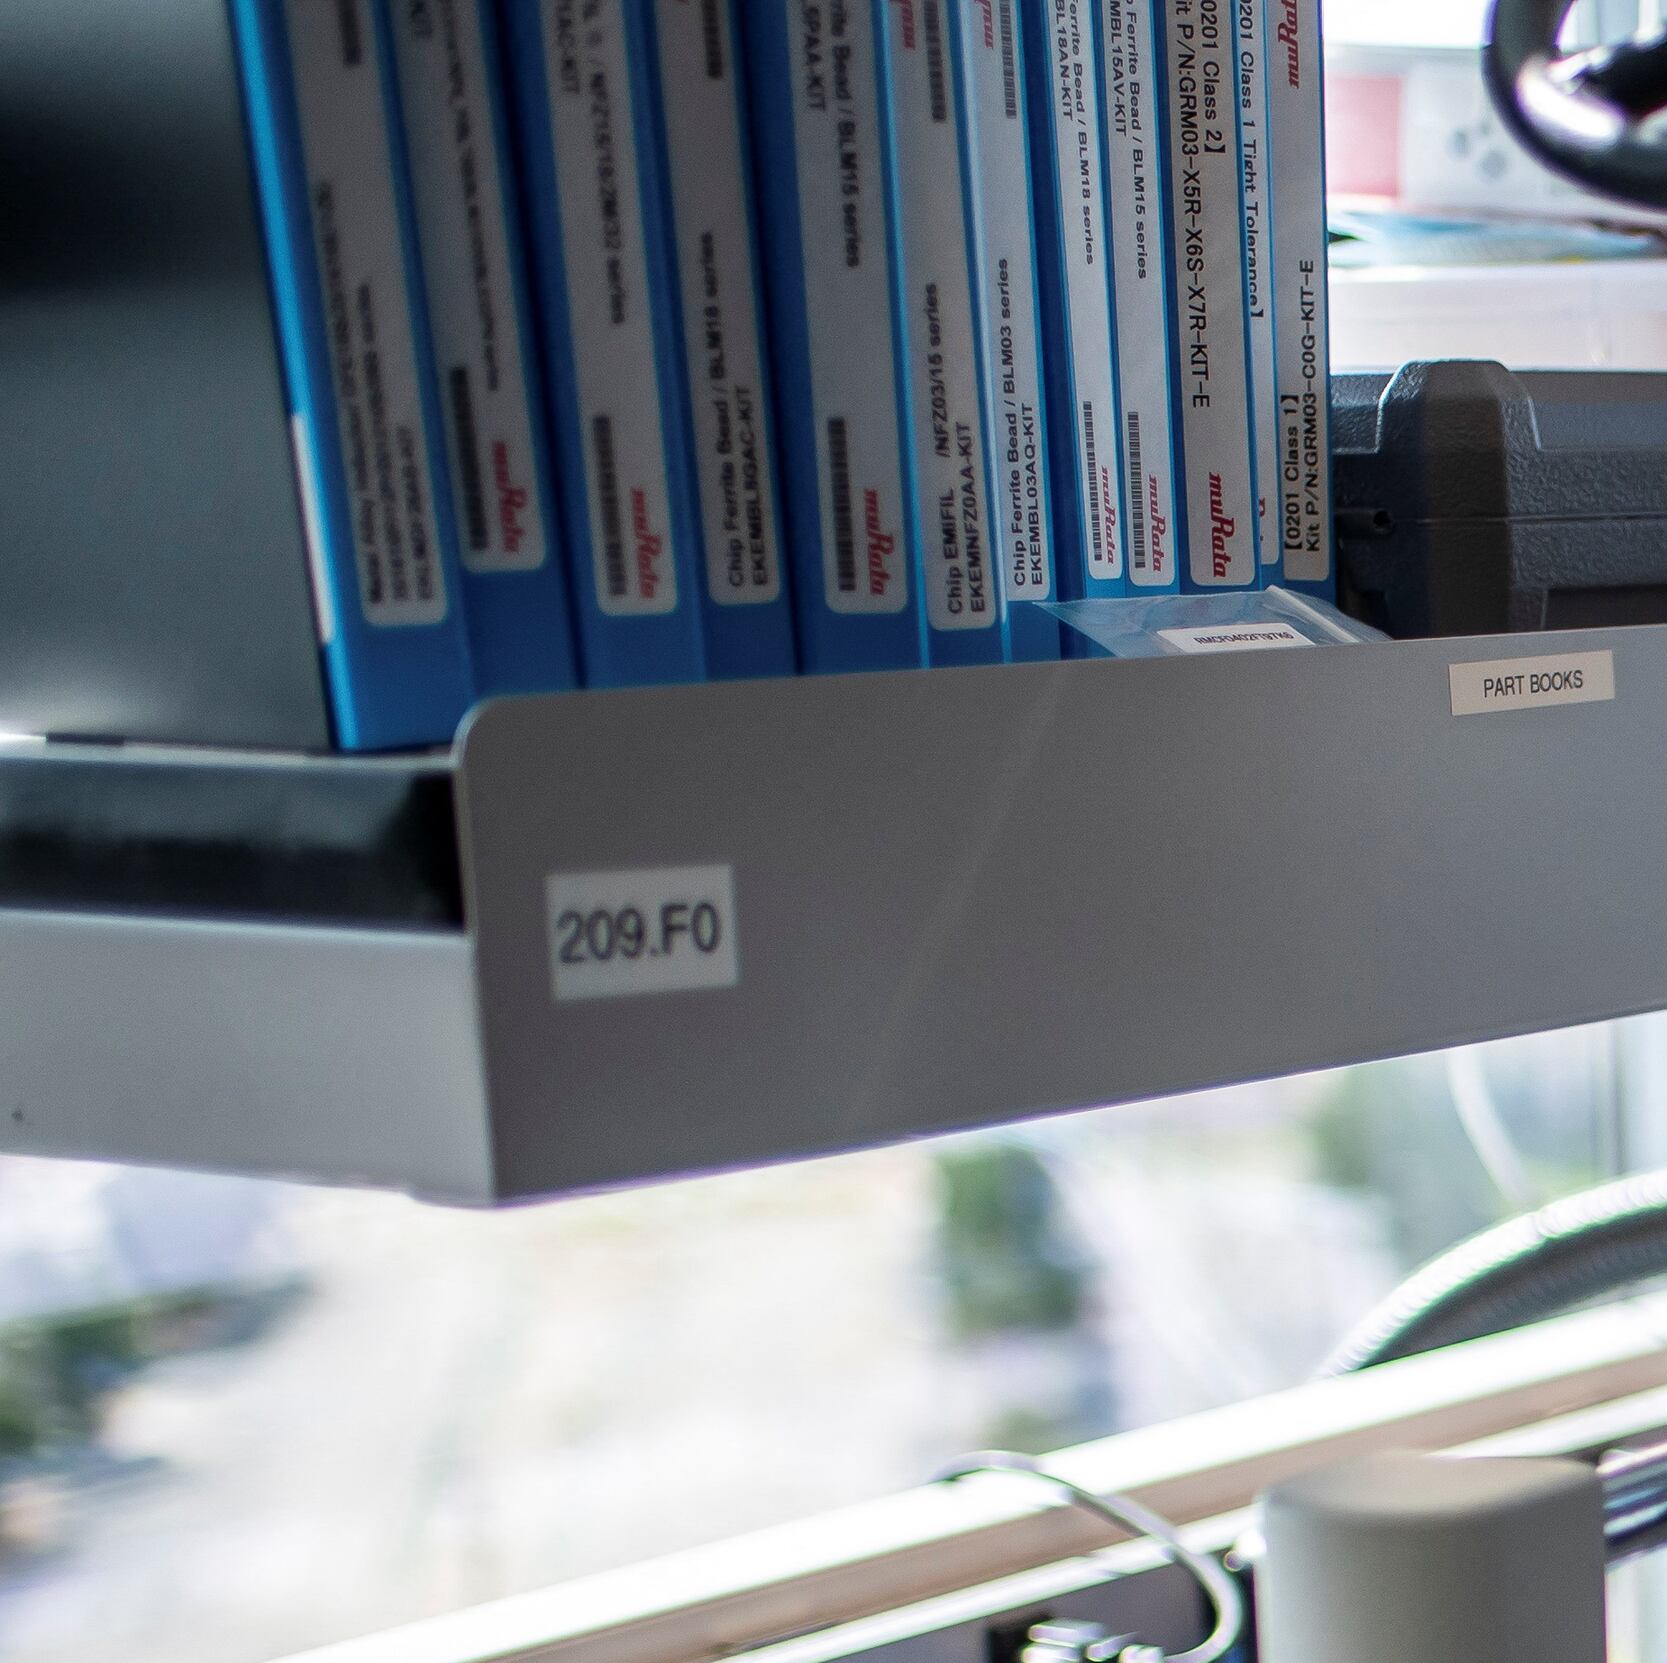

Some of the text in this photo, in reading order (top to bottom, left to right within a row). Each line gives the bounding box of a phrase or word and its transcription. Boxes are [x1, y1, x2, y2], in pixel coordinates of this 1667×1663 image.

[1069, 0, 1080, 56] errite
[1126, 12, 1137, 76] Ferrite
[1278, 0, 1299, 89] muRat
[833, 45, 852, 100] Bead
[1072, 63, 1086, 113] Bead
[1203, 61, 1220, 121] Class
[1241, 51, 1253, 109] Class
[1129, 81, 1142, 131] Bead
[838, 120, 860, 196] BLM15
[1078, 131, 1091, 199] BLM18
[1133, 149, 1146, 215] BLM15
[1244, 140, 1257, 192] Tight
[842, 203, 860, 268] series
[1082, 205, 1094, 265] series
[1176, 24, 1210, 408] P/N:GRM03-X5R-X6S-X7R-KIT-E
[702, 231, 718, 297] series
[1135, 221, 1147, 280] series
[926, 283, 941, 347] series
[998, 258, 1011, 319] series
[1000, 325, 1015, 395] BLM03
[714, 401, 731, 455] Bead
[1007, 412, 1019, 462] Bead
[1283, 426, 1300, 482] Class
[721, 461, 737, 531] Ferrite
[1011, 469, 1023, 534] Ferrite
[1021, 403, 1043, 585] EKEMBL03AQ-KIT
[1101, 465, 1117, 565] muRata
[1149, 473, 1166, 572] muRata
[1209, 472, 1235, 577] muRata
[631, 487, 662, 598] muRata
[729, 538, 745, 587] Chip
[864, 488, 894, 595] muRata
[1014, 541, 1026, 586] Chip
[1306, 525, 1320, 551] Kit
[946, 566, 963, 613] Chip
[1483, 670, 1584, 698] PART BOOKS
[557, 902, 720, 965] 209.F0
